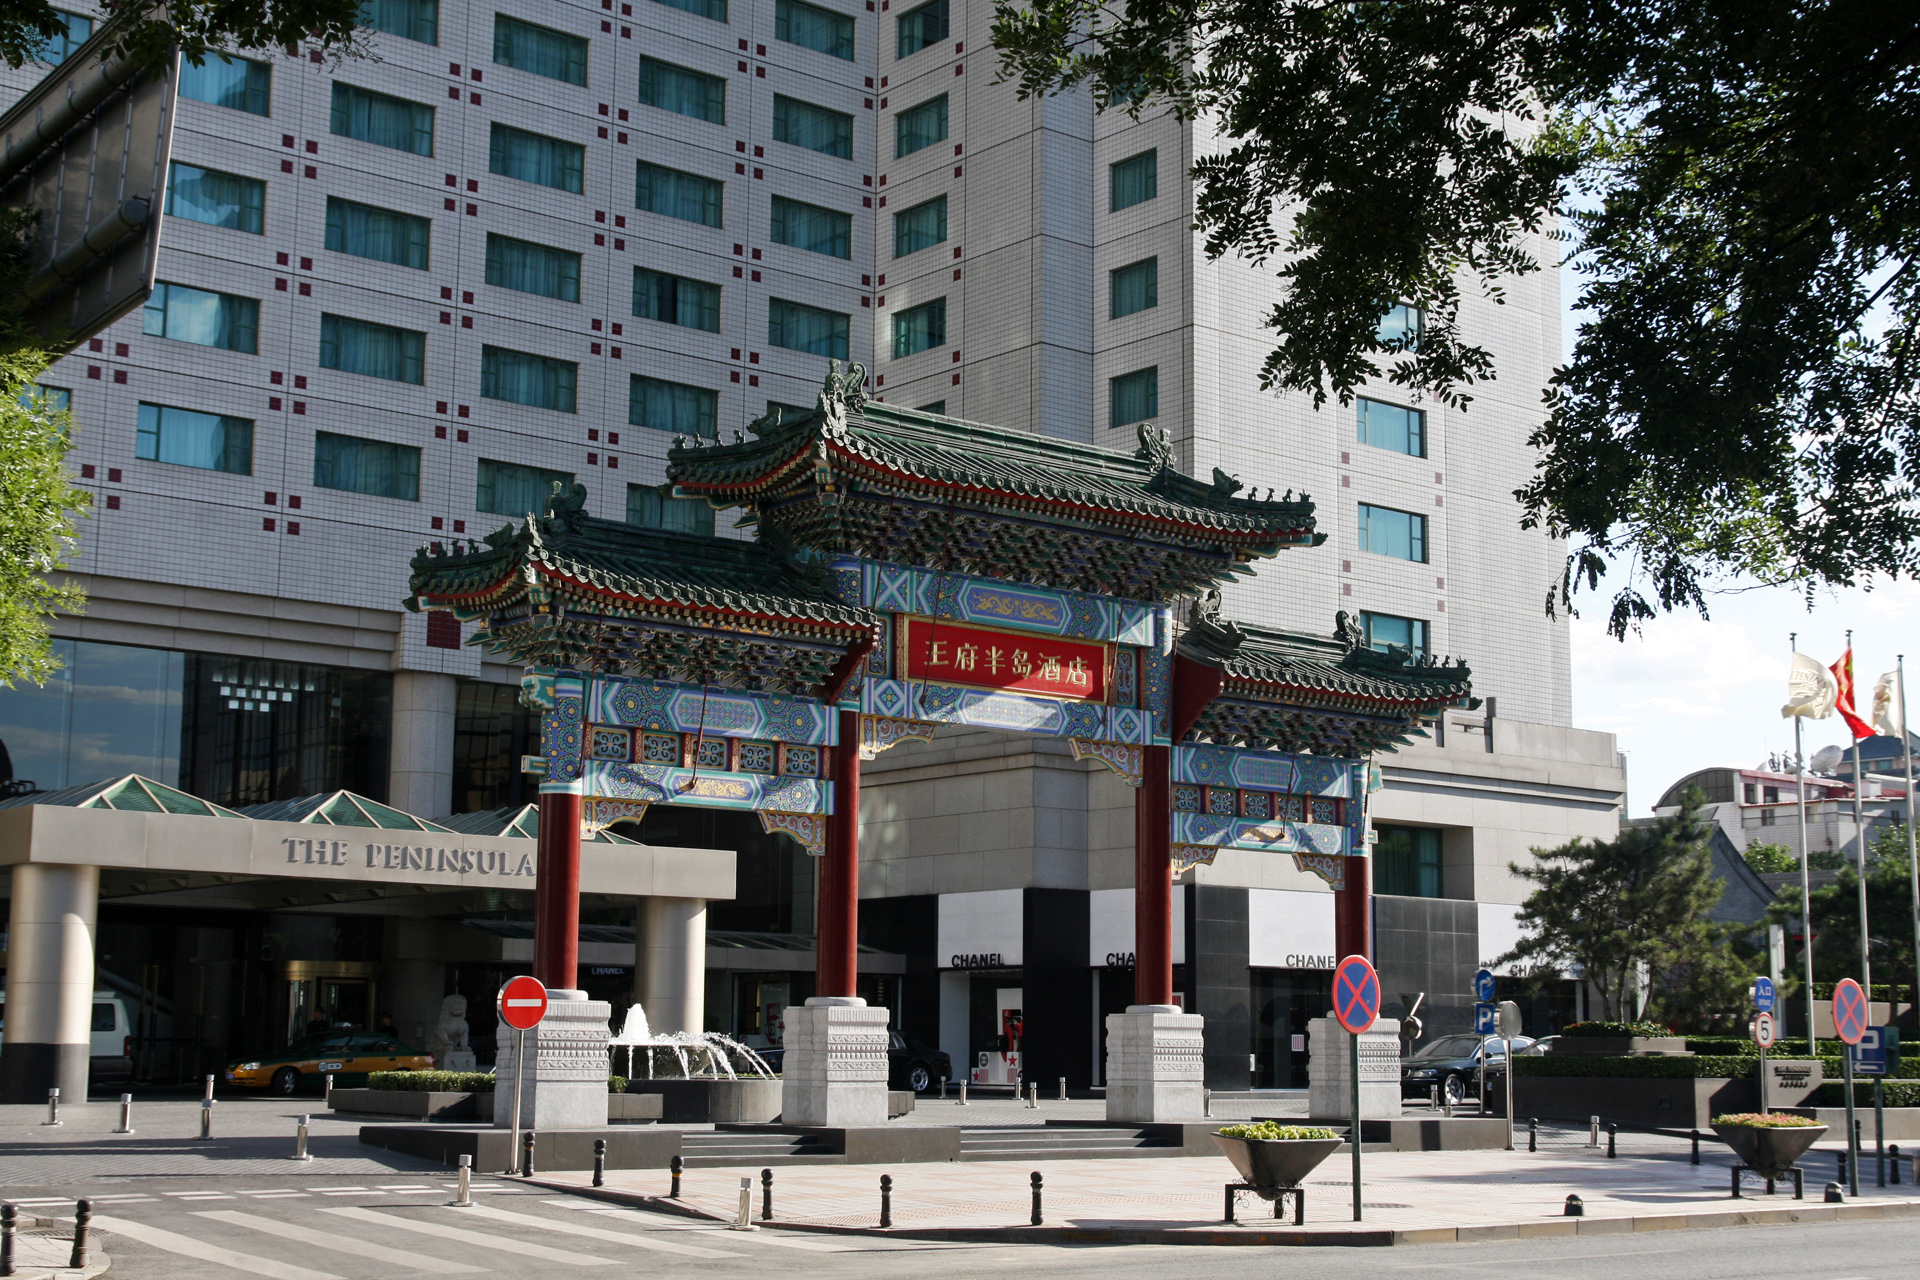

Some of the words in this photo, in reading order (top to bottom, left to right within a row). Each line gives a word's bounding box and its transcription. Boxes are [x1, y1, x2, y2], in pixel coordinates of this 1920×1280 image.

[924, 640, 1089, 687] 王府半岛酒店
[283, 837, 349, 865] THE
[366, 843, 537, 877] PENINSULA
[951, 953, 1004, 968] CHANEL
[1106, 952, 1136, 967] CHA
[1285, 954, 1335, 969] CHANE
[591, 967, 625, 975] CHANEL
[1509, 964, 1538, 977] CHA
[1758, 985, 1772, 997] 入口
[1479, 1007, 1492, 1031] P
[1761, 1020, 1770, 1041] 5
[1857, 1030, 1879, 1060] P
